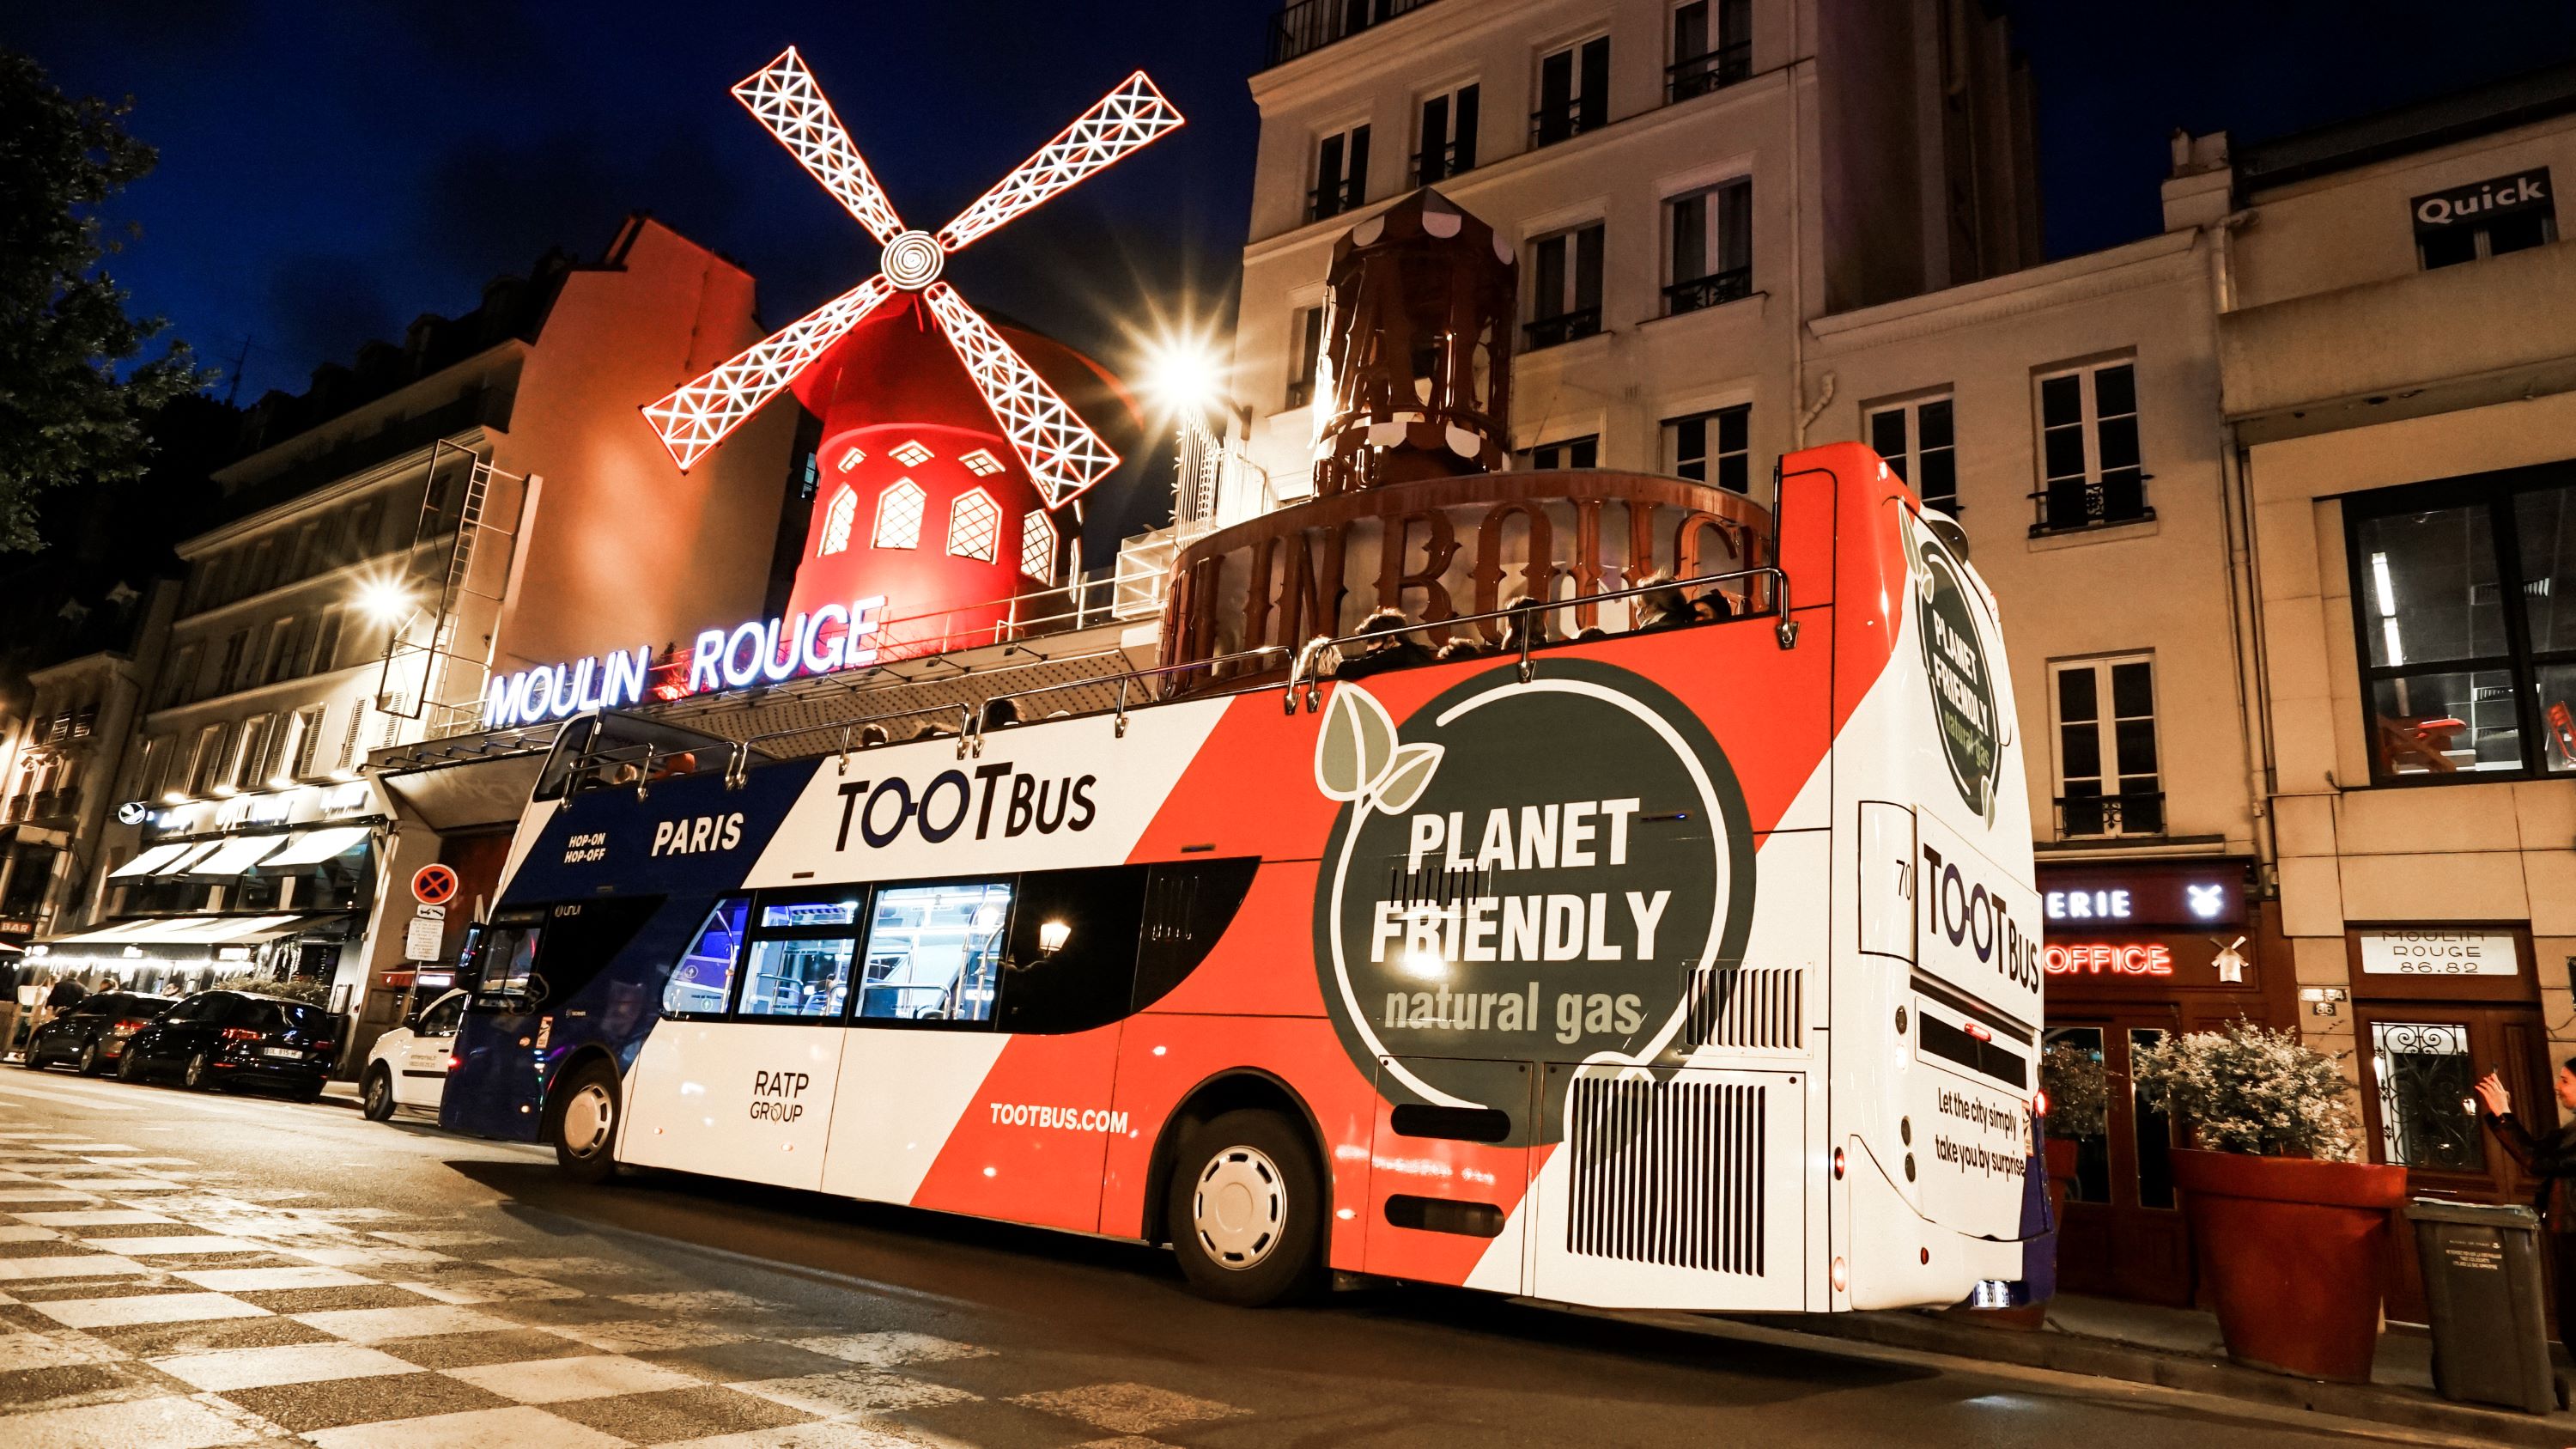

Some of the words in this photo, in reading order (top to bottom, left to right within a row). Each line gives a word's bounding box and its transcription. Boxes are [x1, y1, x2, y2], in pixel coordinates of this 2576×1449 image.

[2417, 177, 2545, 224] Quick
[483, 645, 651, 728] MOULIN
[689, 595, 885, 692] ROUGE
[1932, 609, 1978, 685] PLANET
[1932, 660, 1990, 736] FRIENDLY
[1944, 709, 1974, 755] natural
[1976, 743, 1990, 770] gas
[568, 833, 605, 847] HOP-ON
[652, 812, 743, 857] PARIS
[1407, 797, 1641, 875] PLANET
[565, 849, 605, 863] HOP-OFF
[2, 922, 28, 933] BAR
[1370, 890, 1672, 964] FRIENDLY
[2382, 931, 2483, 942] MOULIN
[2044, 946, 2172, 974] OFFICE
[2393, 946, 2482, 958] ROUGE
[2400, 962, 2478, 973] 86.82
[1384, 981, 1539, 1032] natural
[1555, 992, 1642, 1044] gas
[2316, 1002, 2334, 1014] 86
[754, 1070, 810, 1099] RATP
[750, 1101, 803, 1124] GROUP
[990, 1103, 1127, 1134] TOOTBUS.COM
[1938, 1087, 1952, 1115] Let
[1954, 1093, 1970, 1120] the
[1971, 1097, 1987, 1133] city
[1990, 1103, 2016, 1142] simply
[1935, 1135, 1958, 1162] take
[1959, 1144, 1978, 1173] you
[1978, 1143, 1990, 1178] by
[1991, 1150, 2026, 1182] surprise
